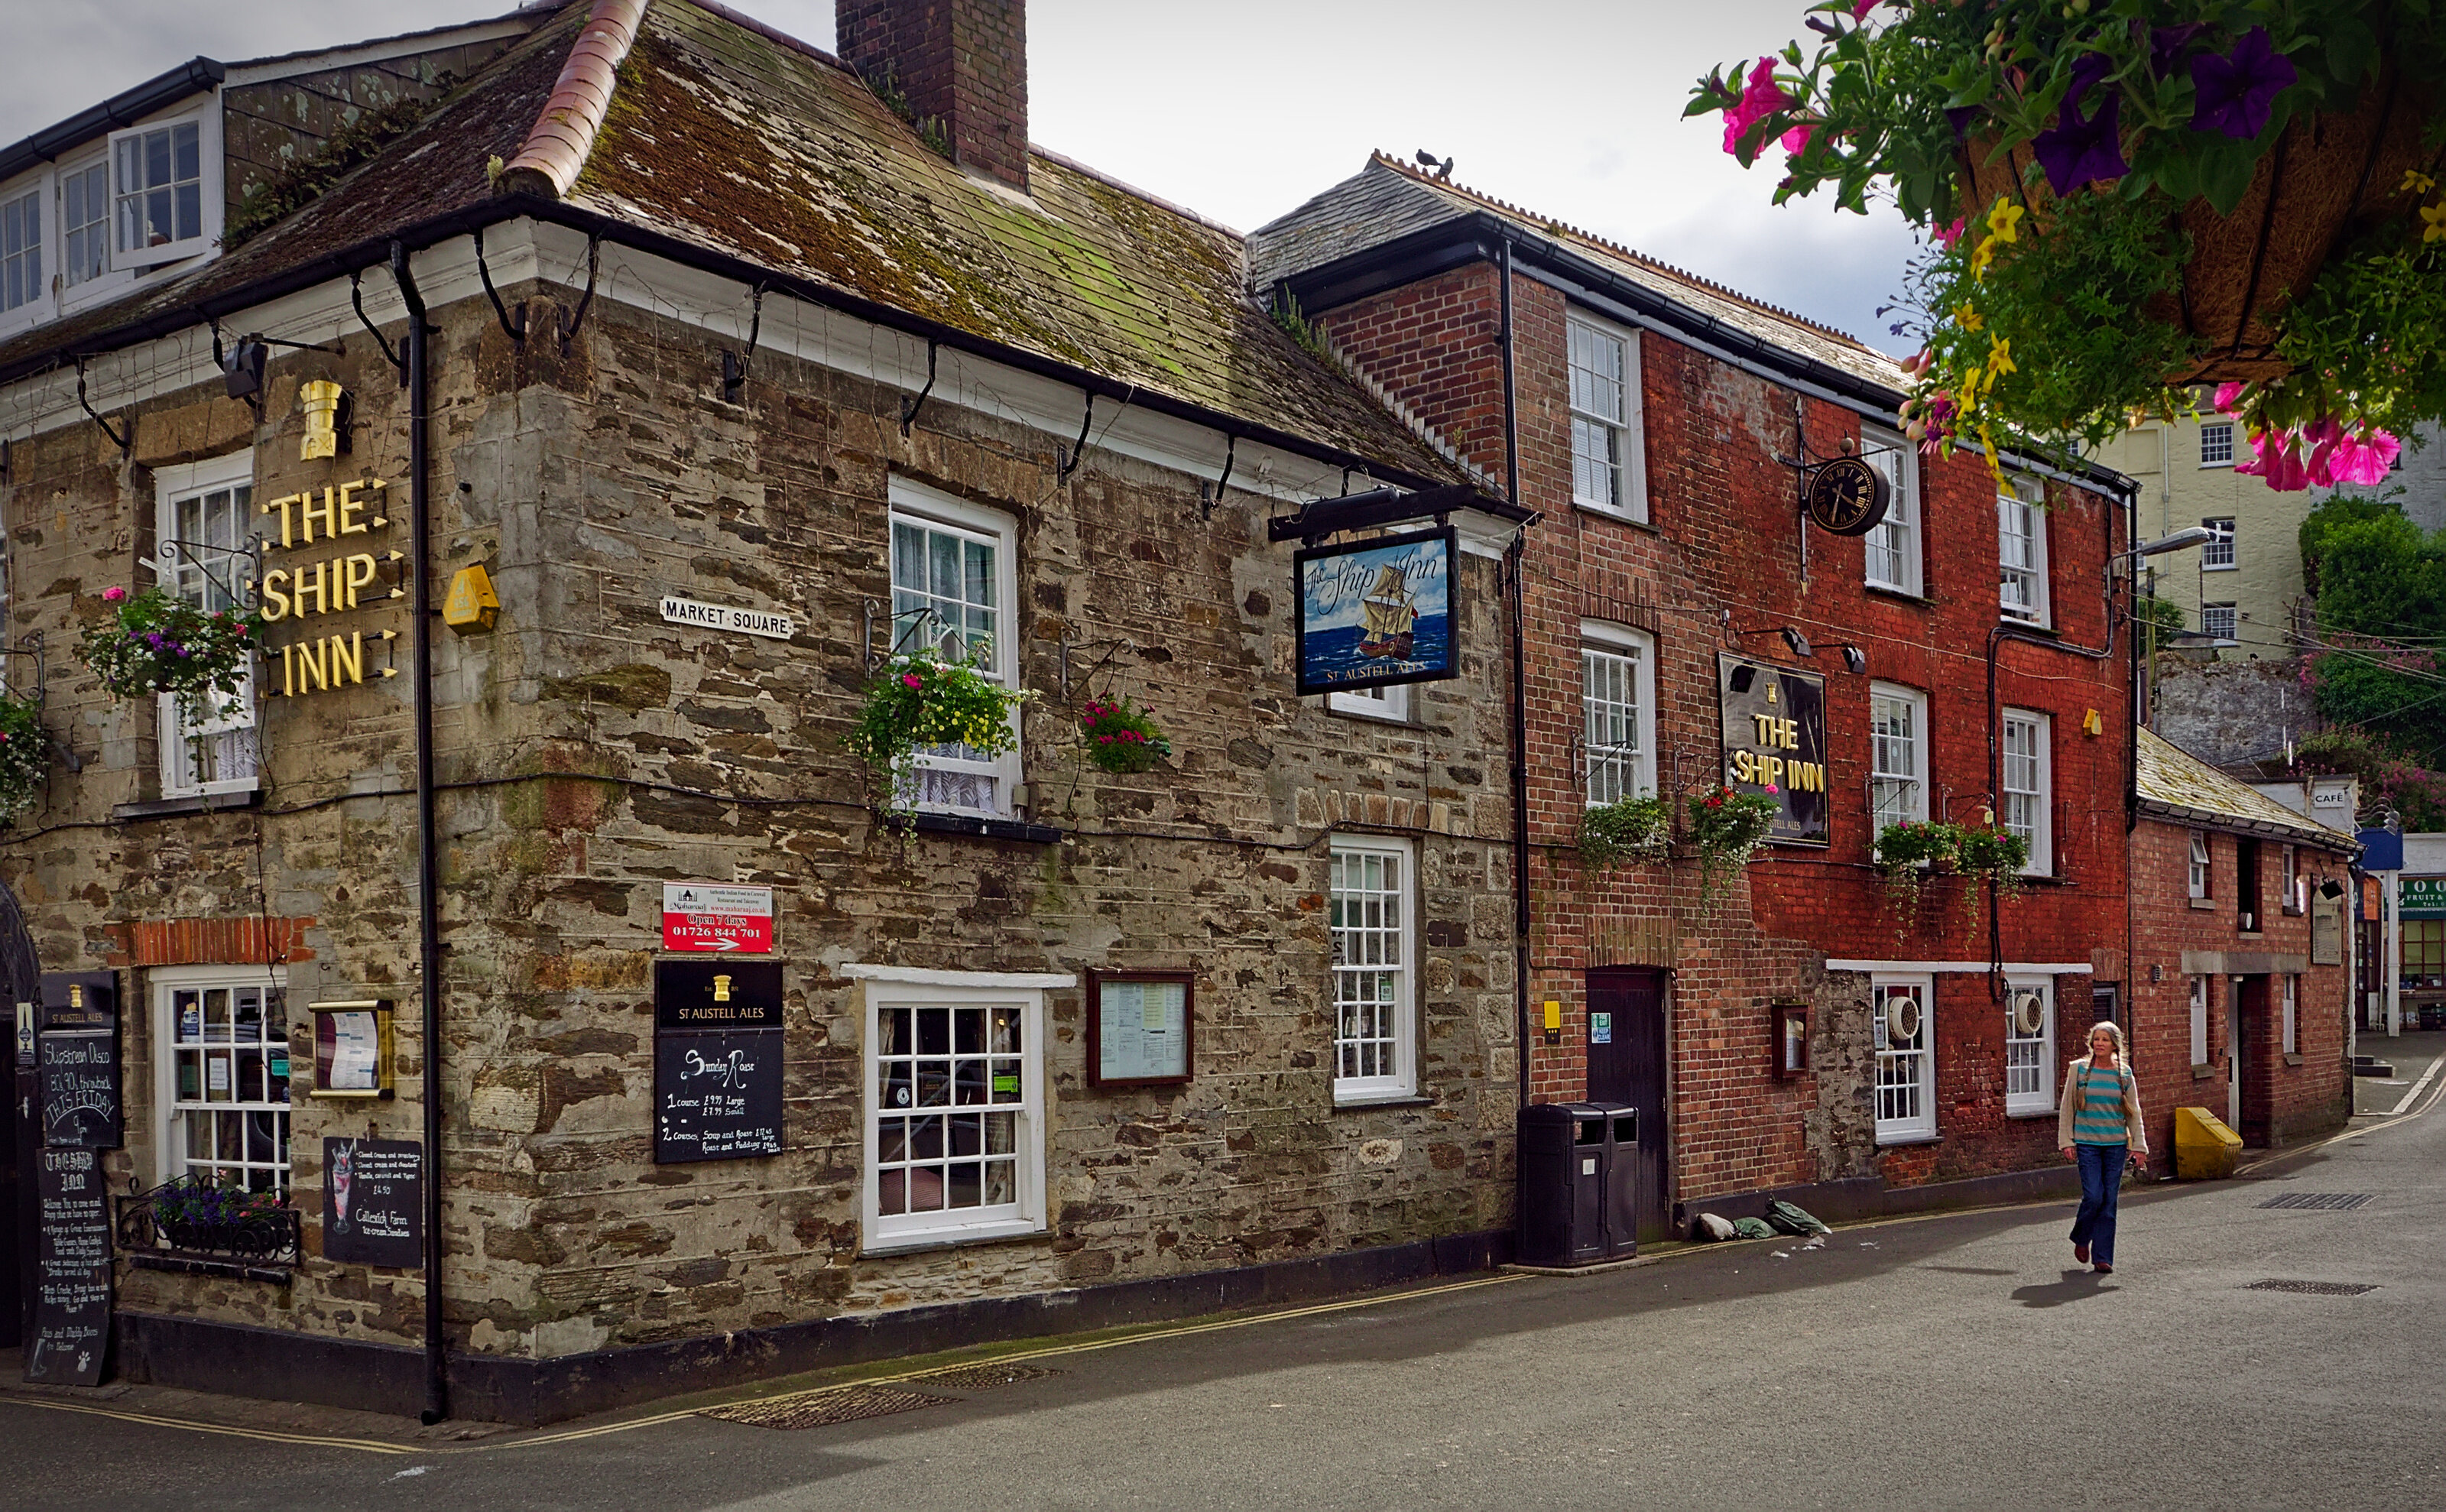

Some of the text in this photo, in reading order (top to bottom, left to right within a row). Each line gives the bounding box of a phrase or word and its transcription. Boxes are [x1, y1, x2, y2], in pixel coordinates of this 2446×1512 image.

[270, 479, 368, 548] THE
[261, 553, 376, 622] SHIP
[1305, 547, 1437, 615] The Ship Inn
[666, 601, 788, 634] MARKET SQUARE
[282, 631, 363, 697] INN
[1345, 664, 1393, 680] AUSTELL
[1397, 660, 1426, 674] ALES
[1755, 714, 1799, 750] THE
[1735, 750, 1824, 793] SHIP INN
[2315, 793, 2344, 803] CAFÉ
[1787, 820, 1801, 831] ALES
[670, 902, 706, 912] Maharaaj
[710, 905, 766, 913] www.maharaaj.co.uk
[687, 913, 747, 928] Open 7 days
[673, 926, 760, 938] 01726 844 701
[60, 1013, 85, 1023] AUSTELL
[87, 1012, 102, 1022] ALES
[691, 1007, 736, 1019] AUSTELL
[739, 1007, 764, 1018] ALES
[45, 1043, 87, 1070] Slipstream
[89, 1042, 109, 1063] Disco
[680, 1050, 754, 1089] Sunday Roast
[46, 1090, 114, 1124] THIS FRIDAY
[667, 1093, 676, 1108] 1
[676, 1098, 699, 1107] course
[726, 1095, 745, 1108] Large
[725, 1107, 745, 1116] Small
[662, 1127, 672, 1140] 2
[702, 1131, 721, 1140] Soup
[736, 1129, 753, 1139] Roast
[702, 1141, 719, 1154] Roast
[735, 1140, 761, 1150] Pudding
[390, 1210, 408, 1225] Farm
